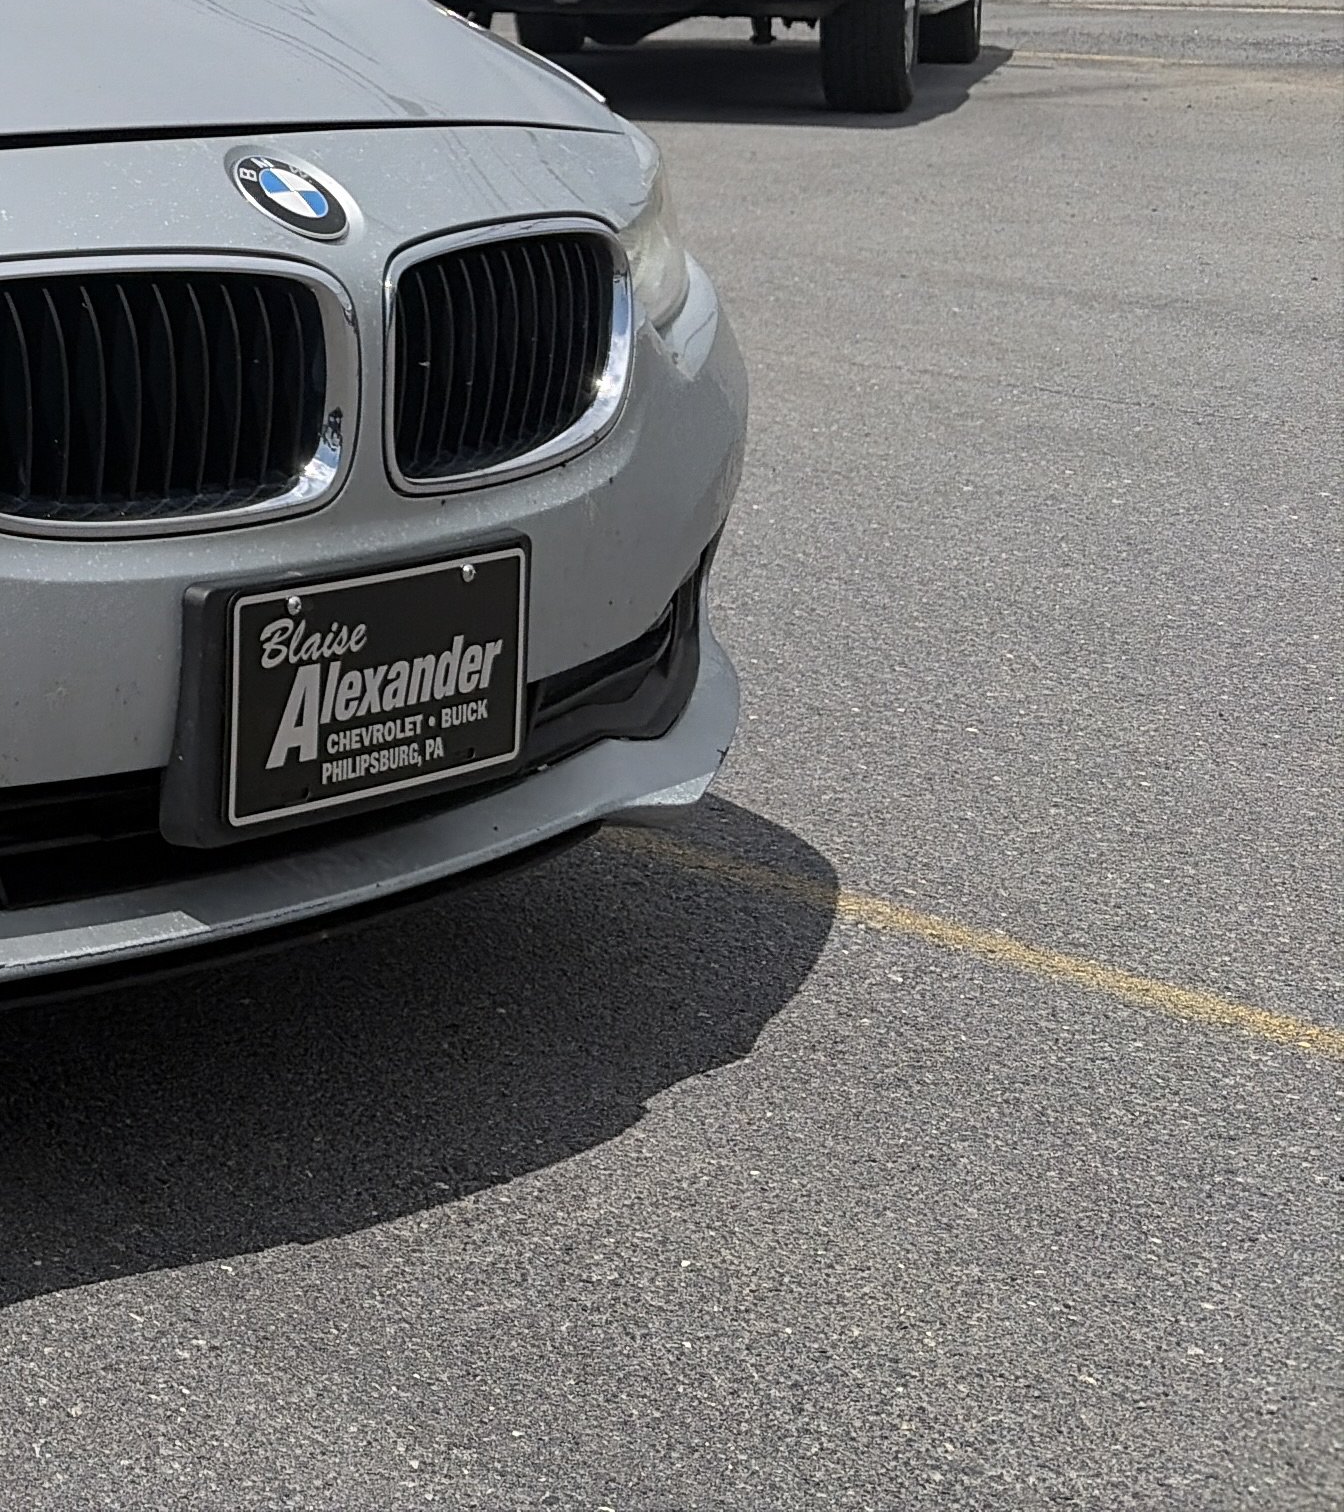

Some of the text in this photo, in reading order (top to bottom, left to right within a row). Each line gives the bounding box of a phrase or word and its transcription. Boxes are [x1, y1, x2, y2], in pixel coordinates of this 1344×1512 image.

[239, 157, 312, 183] BMW
[260, 616, 368, 669] Blaise
[265, 634, 504, 770] Alexander
[326, 698, 489, 755] CHEVROLET BUICK
[321, 736, 445, 785] PHILIPSBURG, PA
